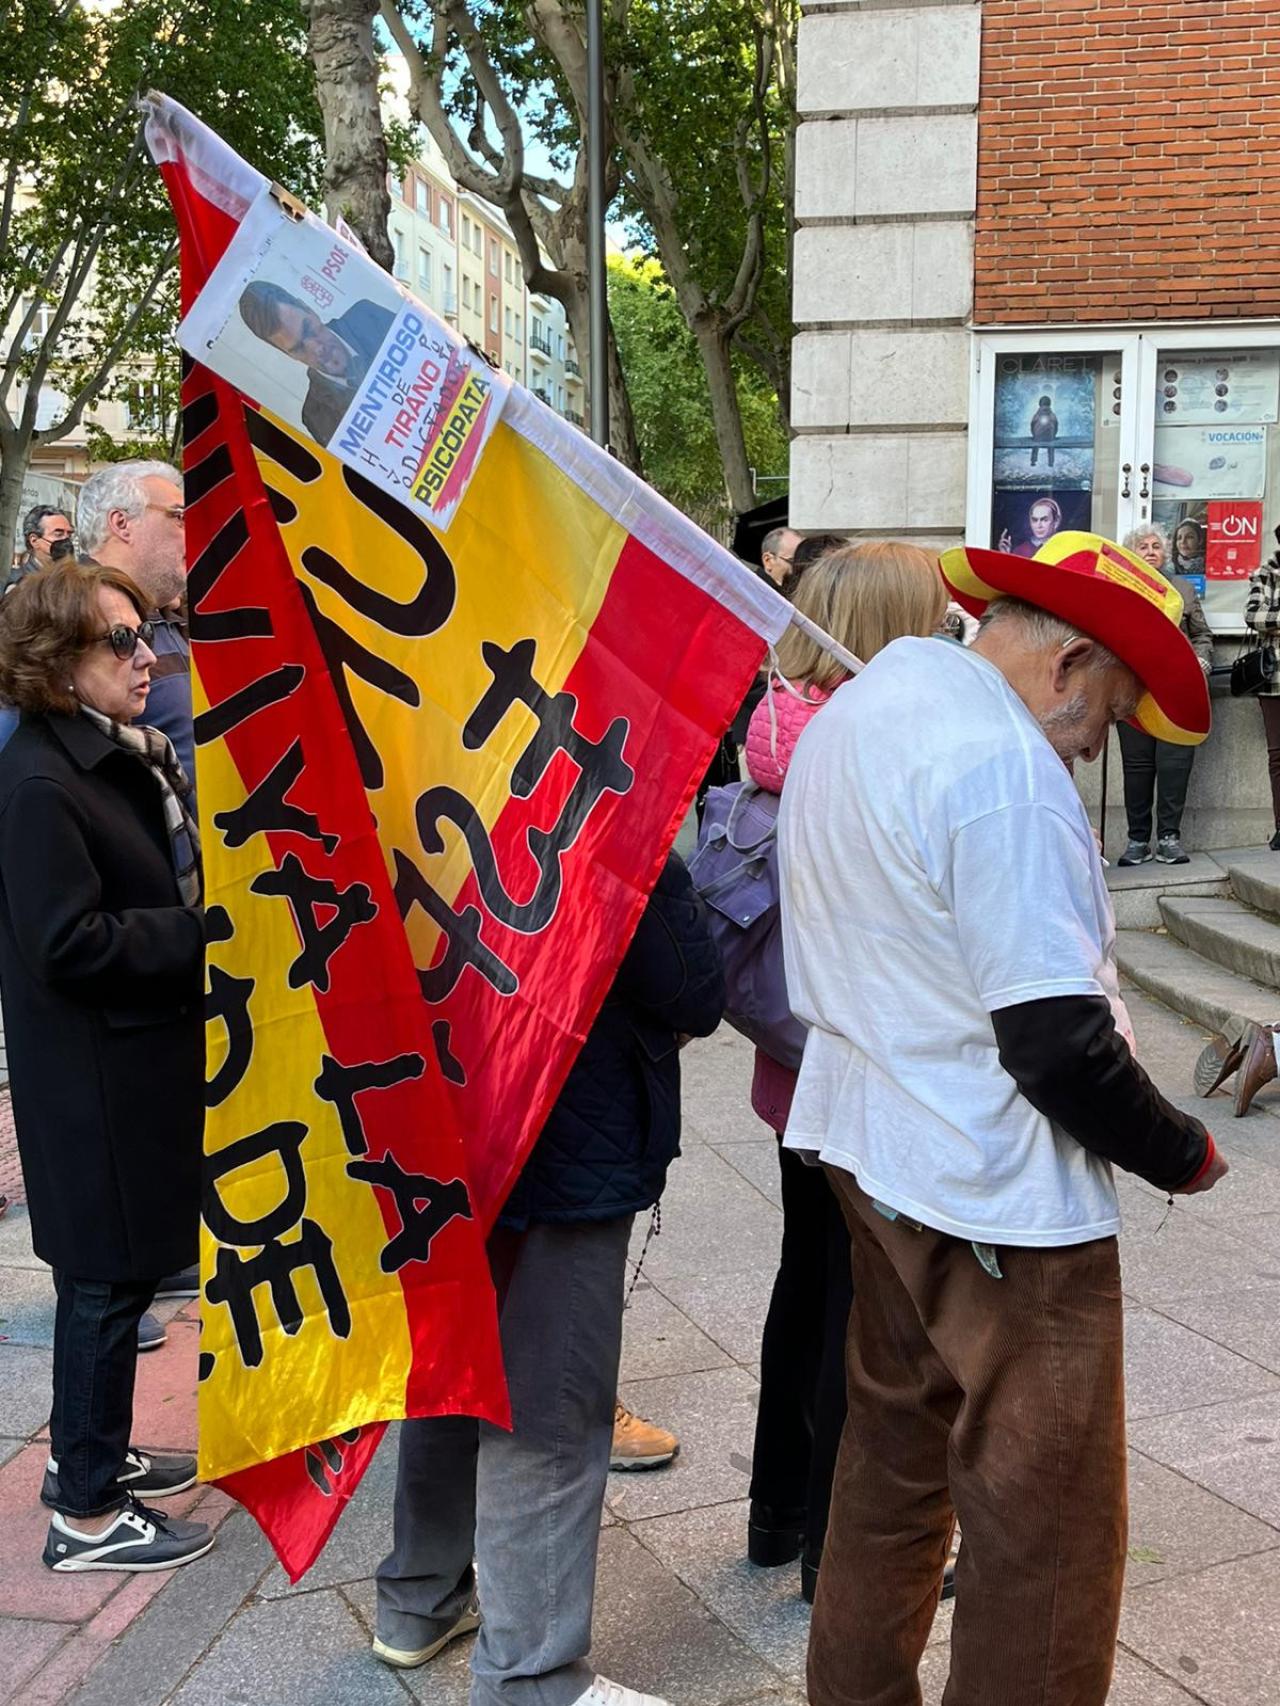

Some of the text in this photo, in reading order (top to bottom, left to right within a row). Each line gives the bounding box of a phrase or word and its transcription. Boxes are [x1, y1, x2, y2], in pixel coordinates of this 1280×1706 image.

[322, 245, 349, 282] PSOE
[340, 313, 423, 456] MENTIROSO
[391, 377, 411, 406] DE
[1001, 356, 1092, 374] CLARET
[384, 359, 441, 448] TIRANO
[414, 376, 490, 508] PSICÓPATA
[1222, 514, 1257, 537] ON
[313, 1052, 475, 1275] LA
